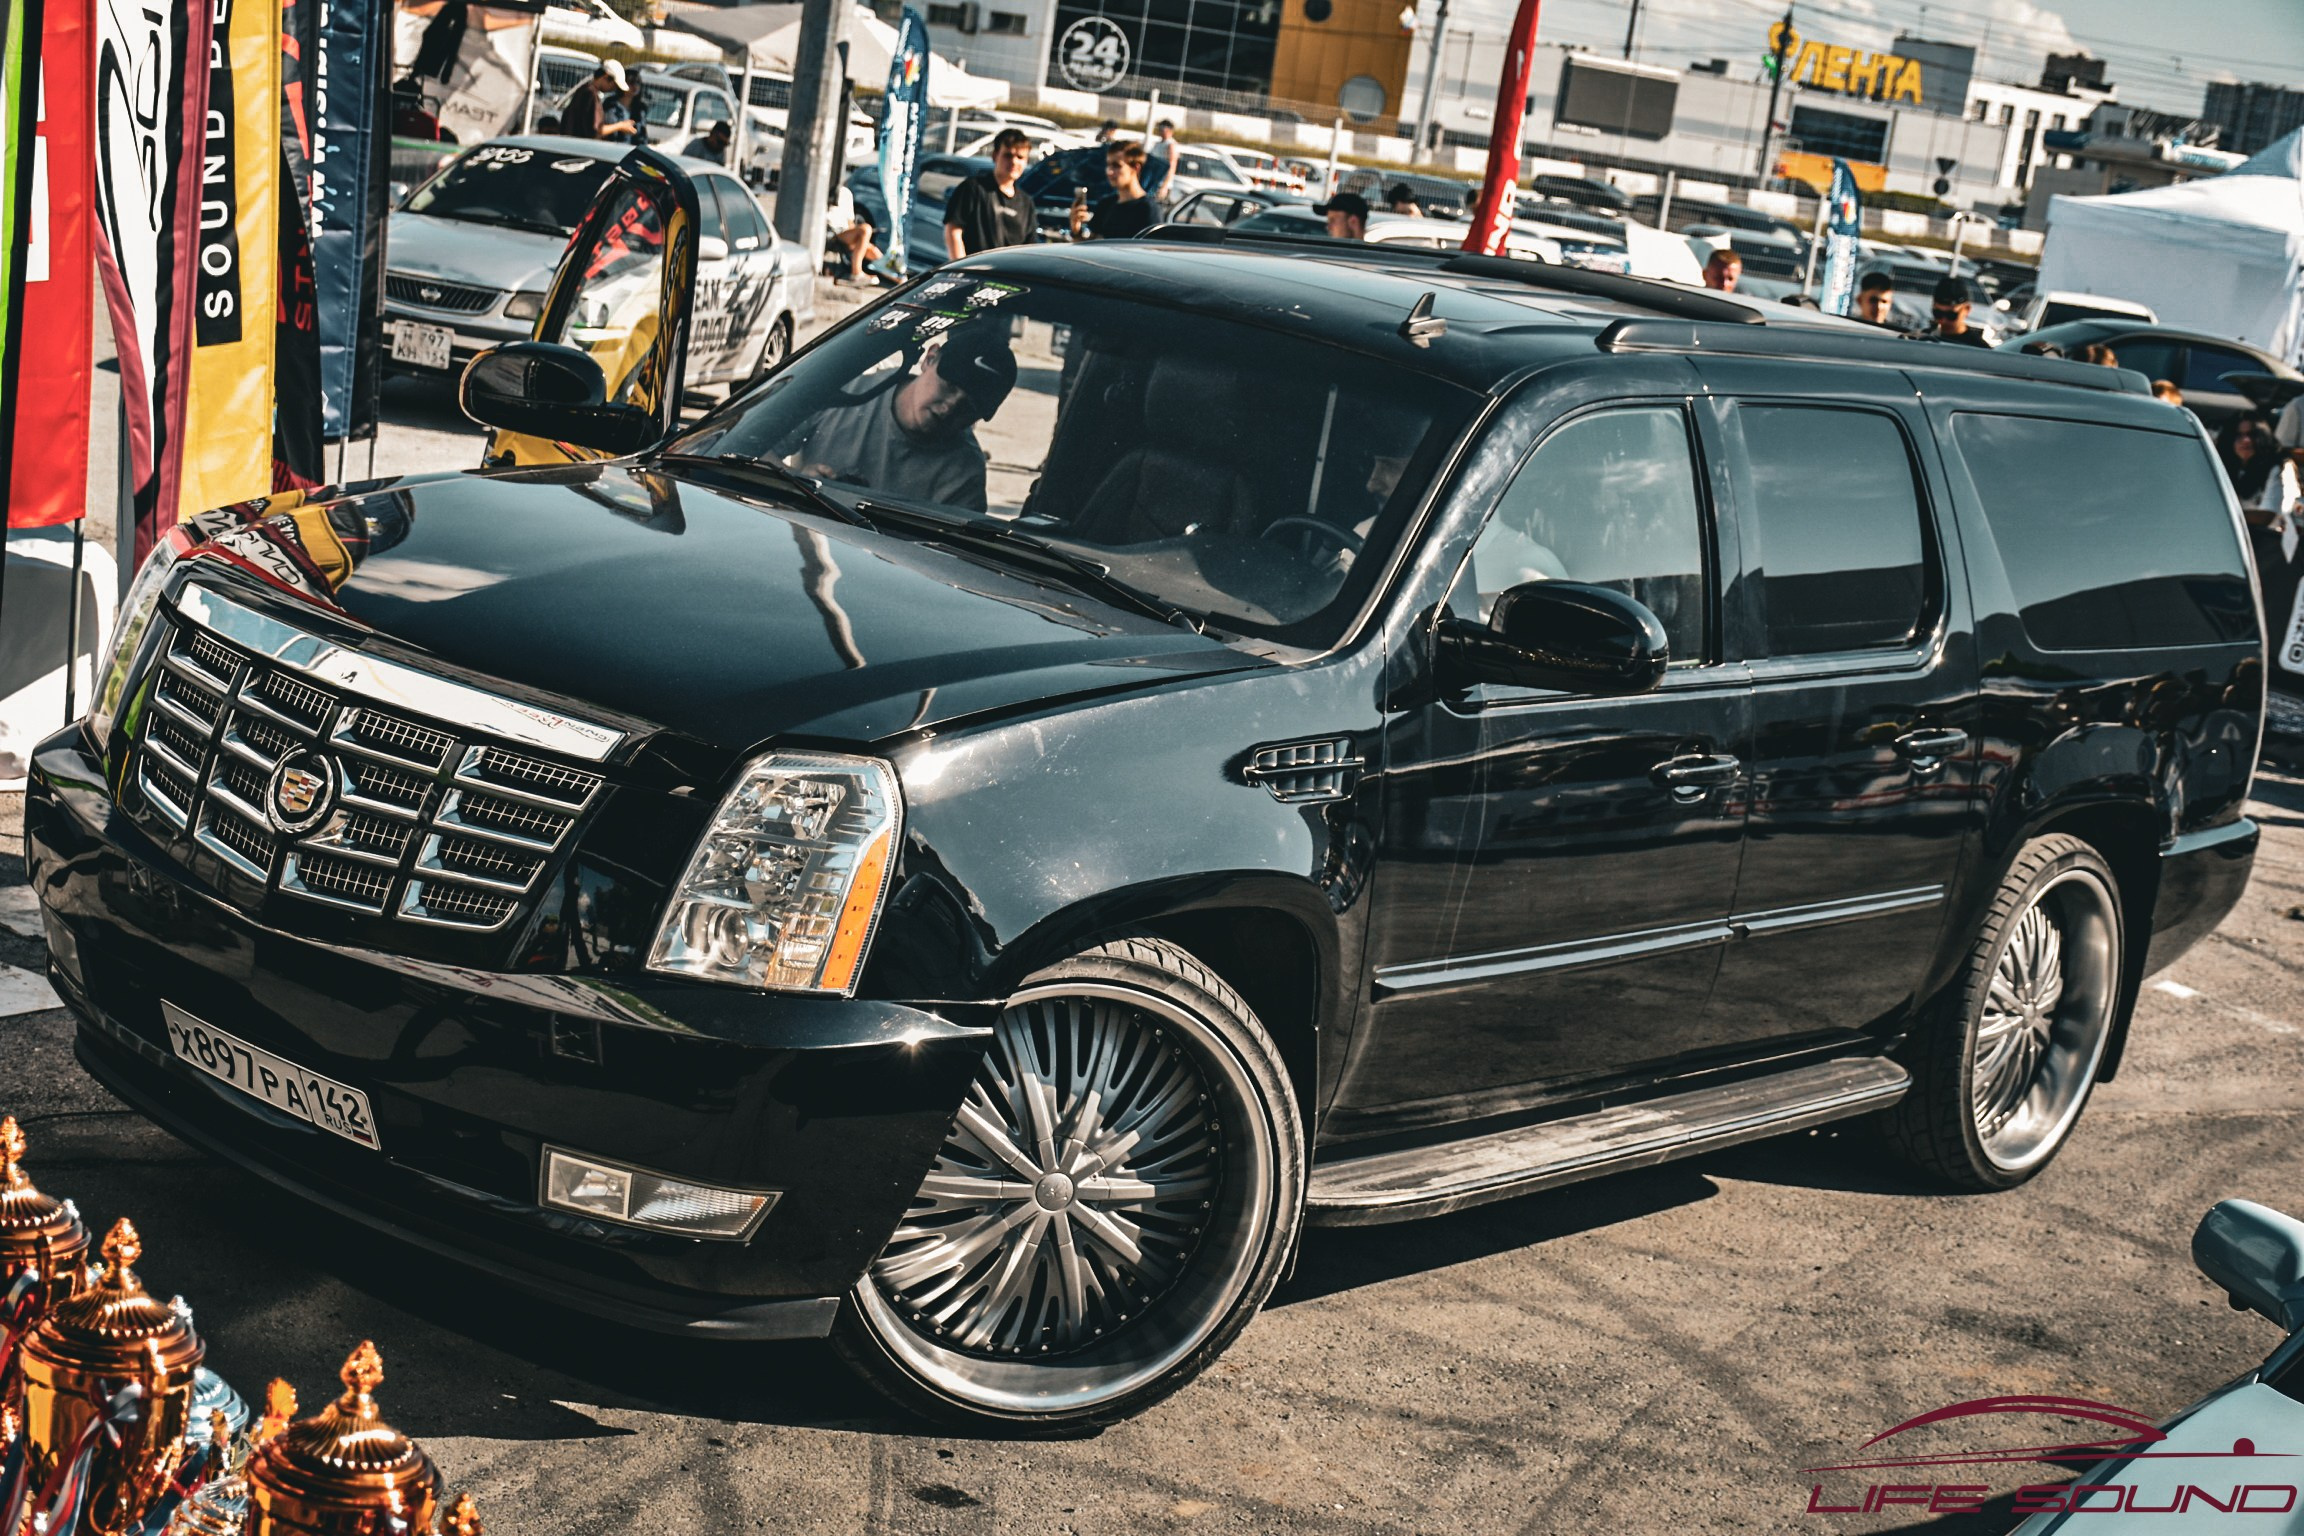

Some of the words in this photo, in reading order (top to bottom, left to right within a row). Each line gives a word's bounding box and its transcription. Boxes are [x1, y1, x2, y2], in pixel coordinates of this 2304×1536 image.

[1070, 30, 1121, 66] 24
[1791, 41, 1923, 106] ЛЕНТА
[199, 109, 234, 318] SOUND
[307, 1079, 365, 1129] 142
[324, 1112, 353, 1134] RUS
